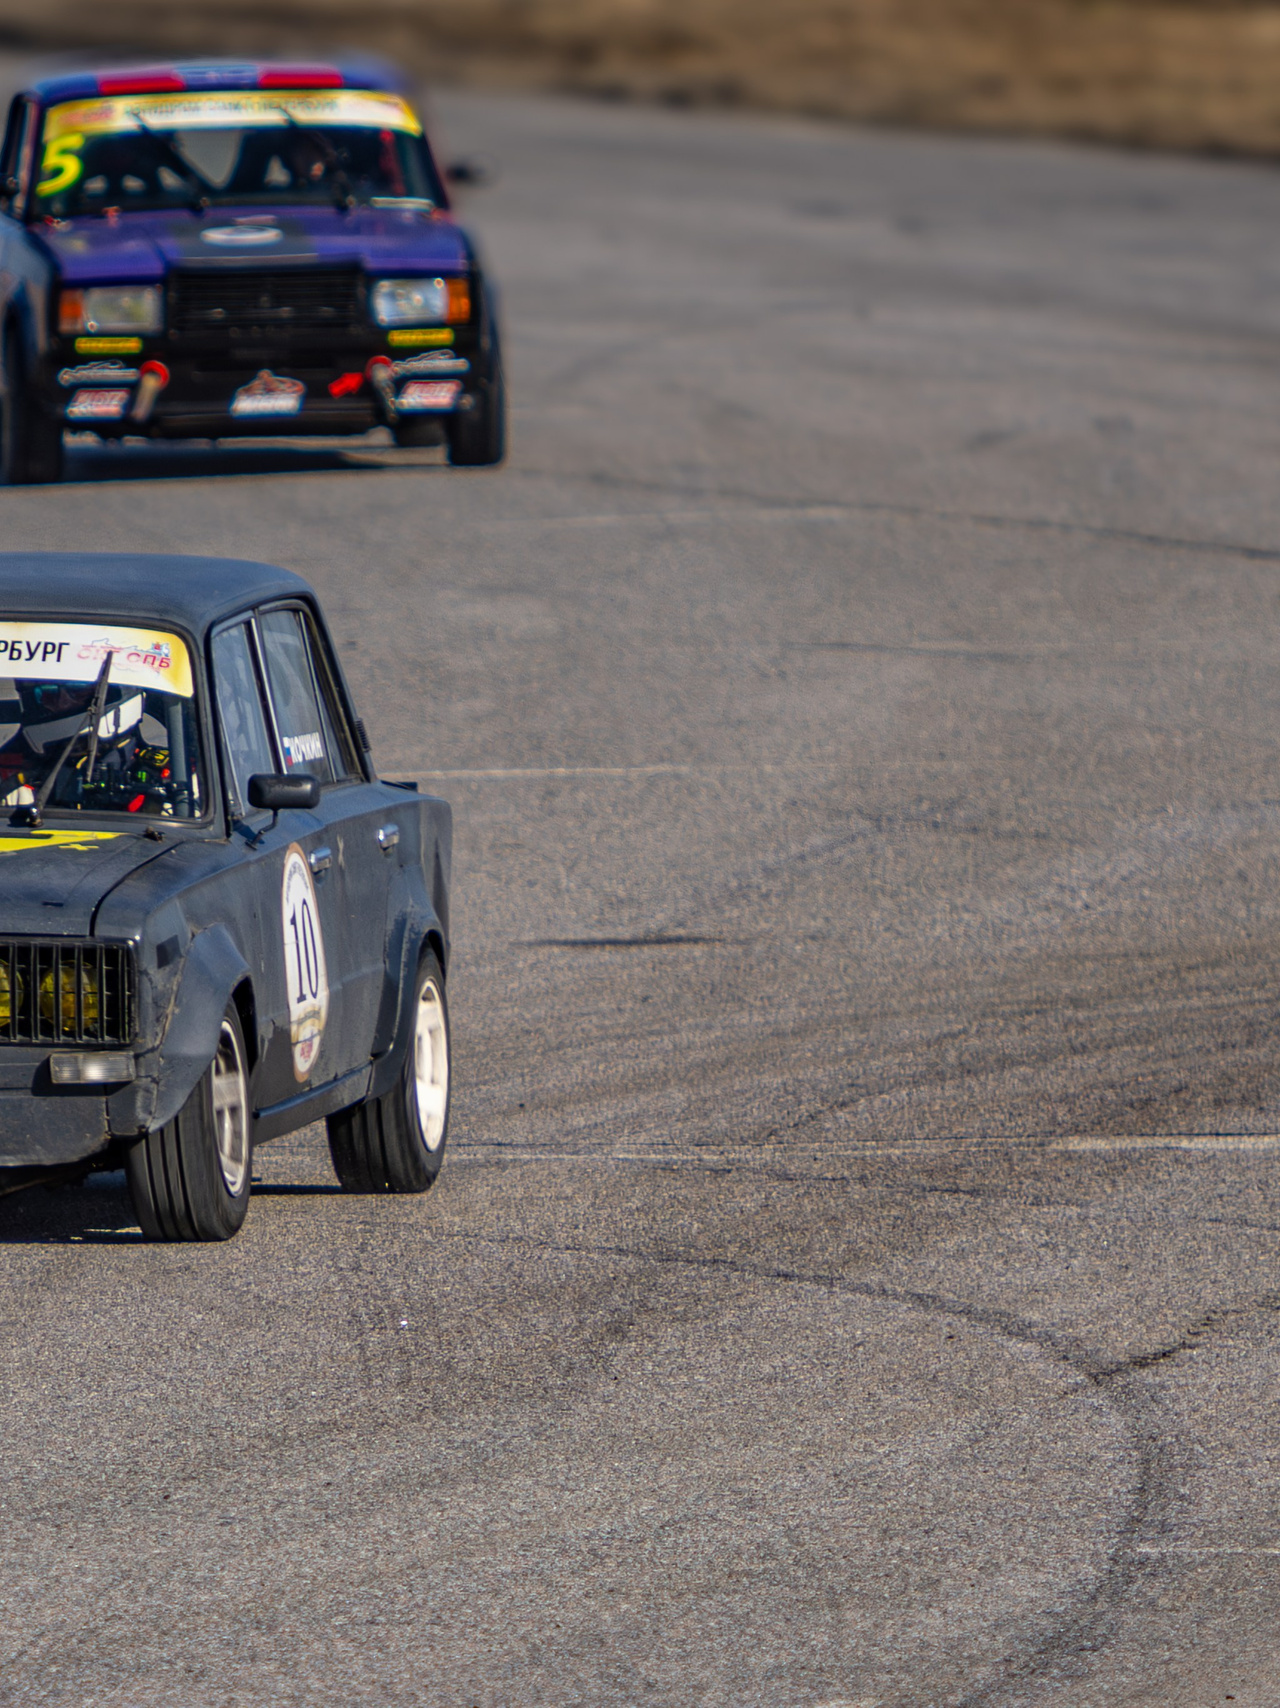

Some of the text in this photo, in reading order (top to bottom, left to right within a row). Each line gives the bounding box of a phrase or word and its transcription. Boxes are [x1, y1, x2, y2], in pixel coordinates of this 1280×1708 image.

[35, 132, 86, 198] 5
[126, 651, 171, 669] СПБ
[290, 897, 319, 1004] 10
